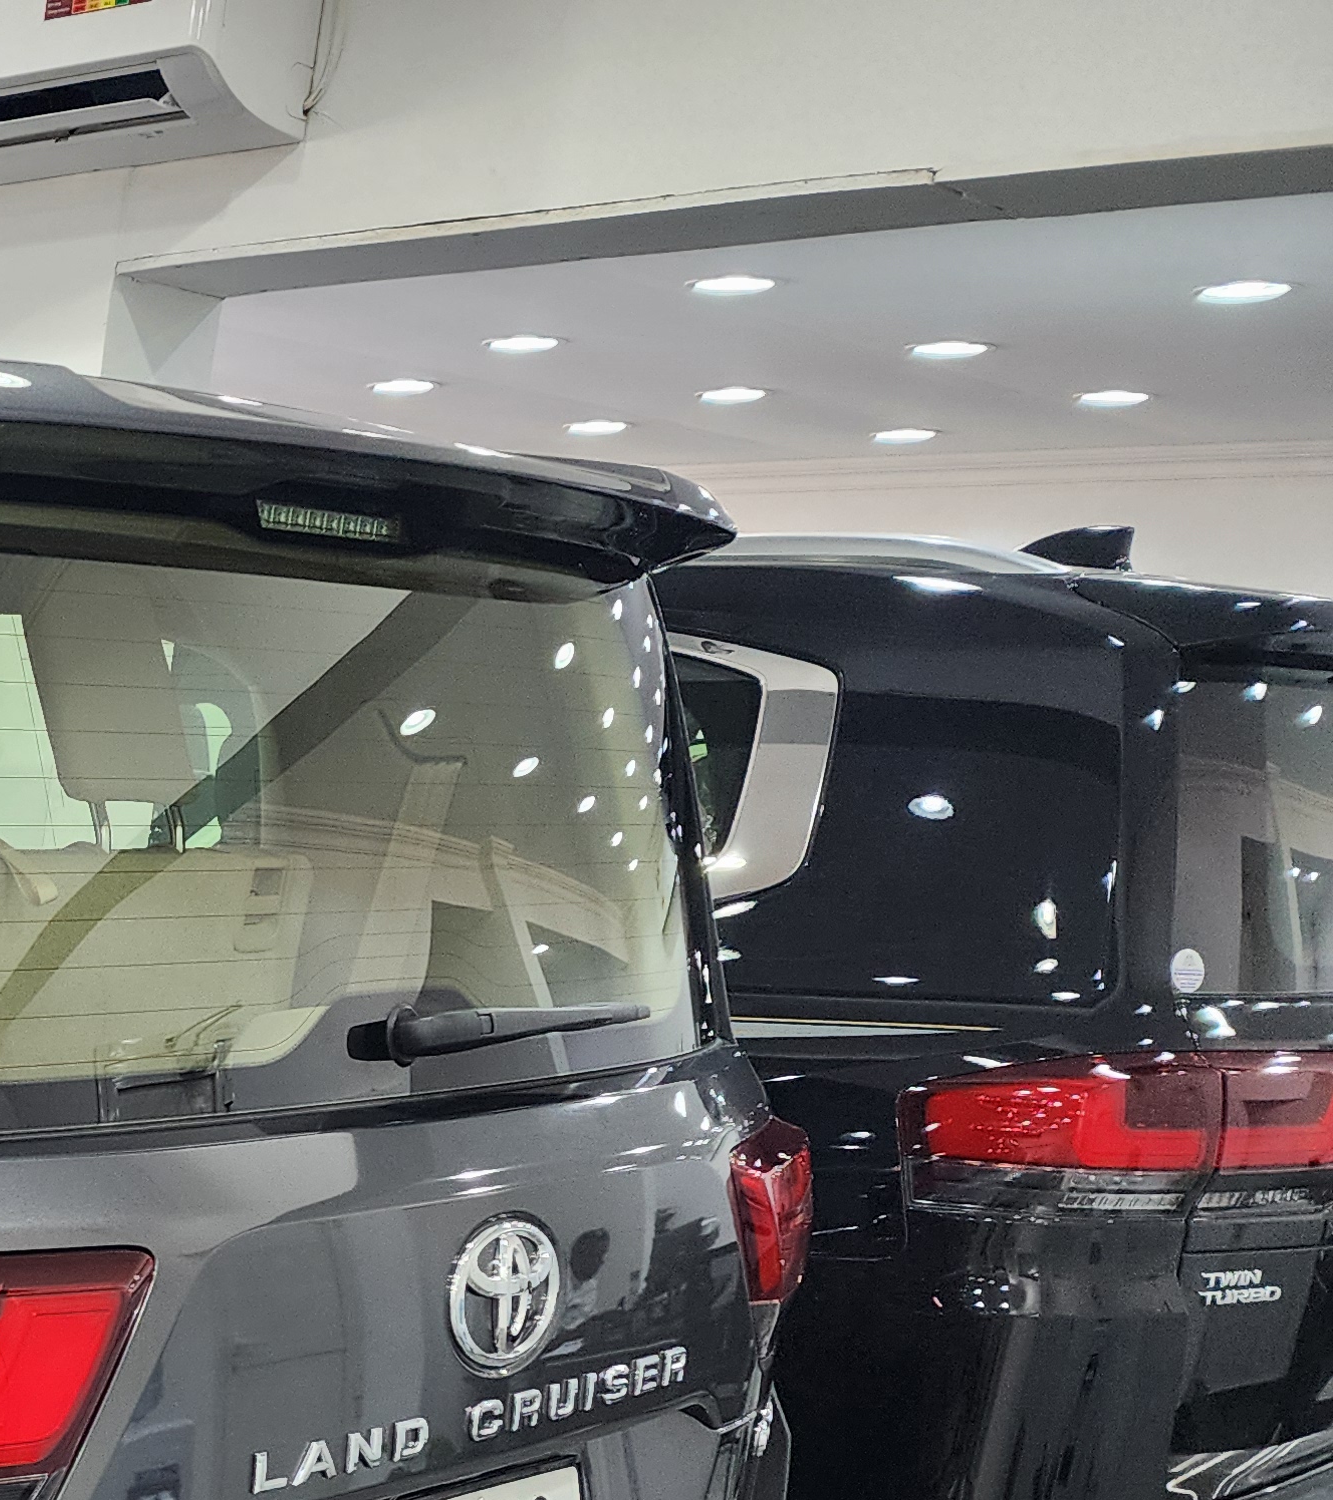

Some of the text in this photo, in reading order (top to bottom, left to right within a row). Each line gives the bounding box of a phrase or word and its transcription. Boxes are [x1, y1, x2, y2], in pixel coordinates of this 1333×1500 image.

[1201, 1268, 1263, 1288] TWIN
[1197, 1286, 1282, 1306] TURBO
[251, 1346, 689, 1495] LAND CRUISER
